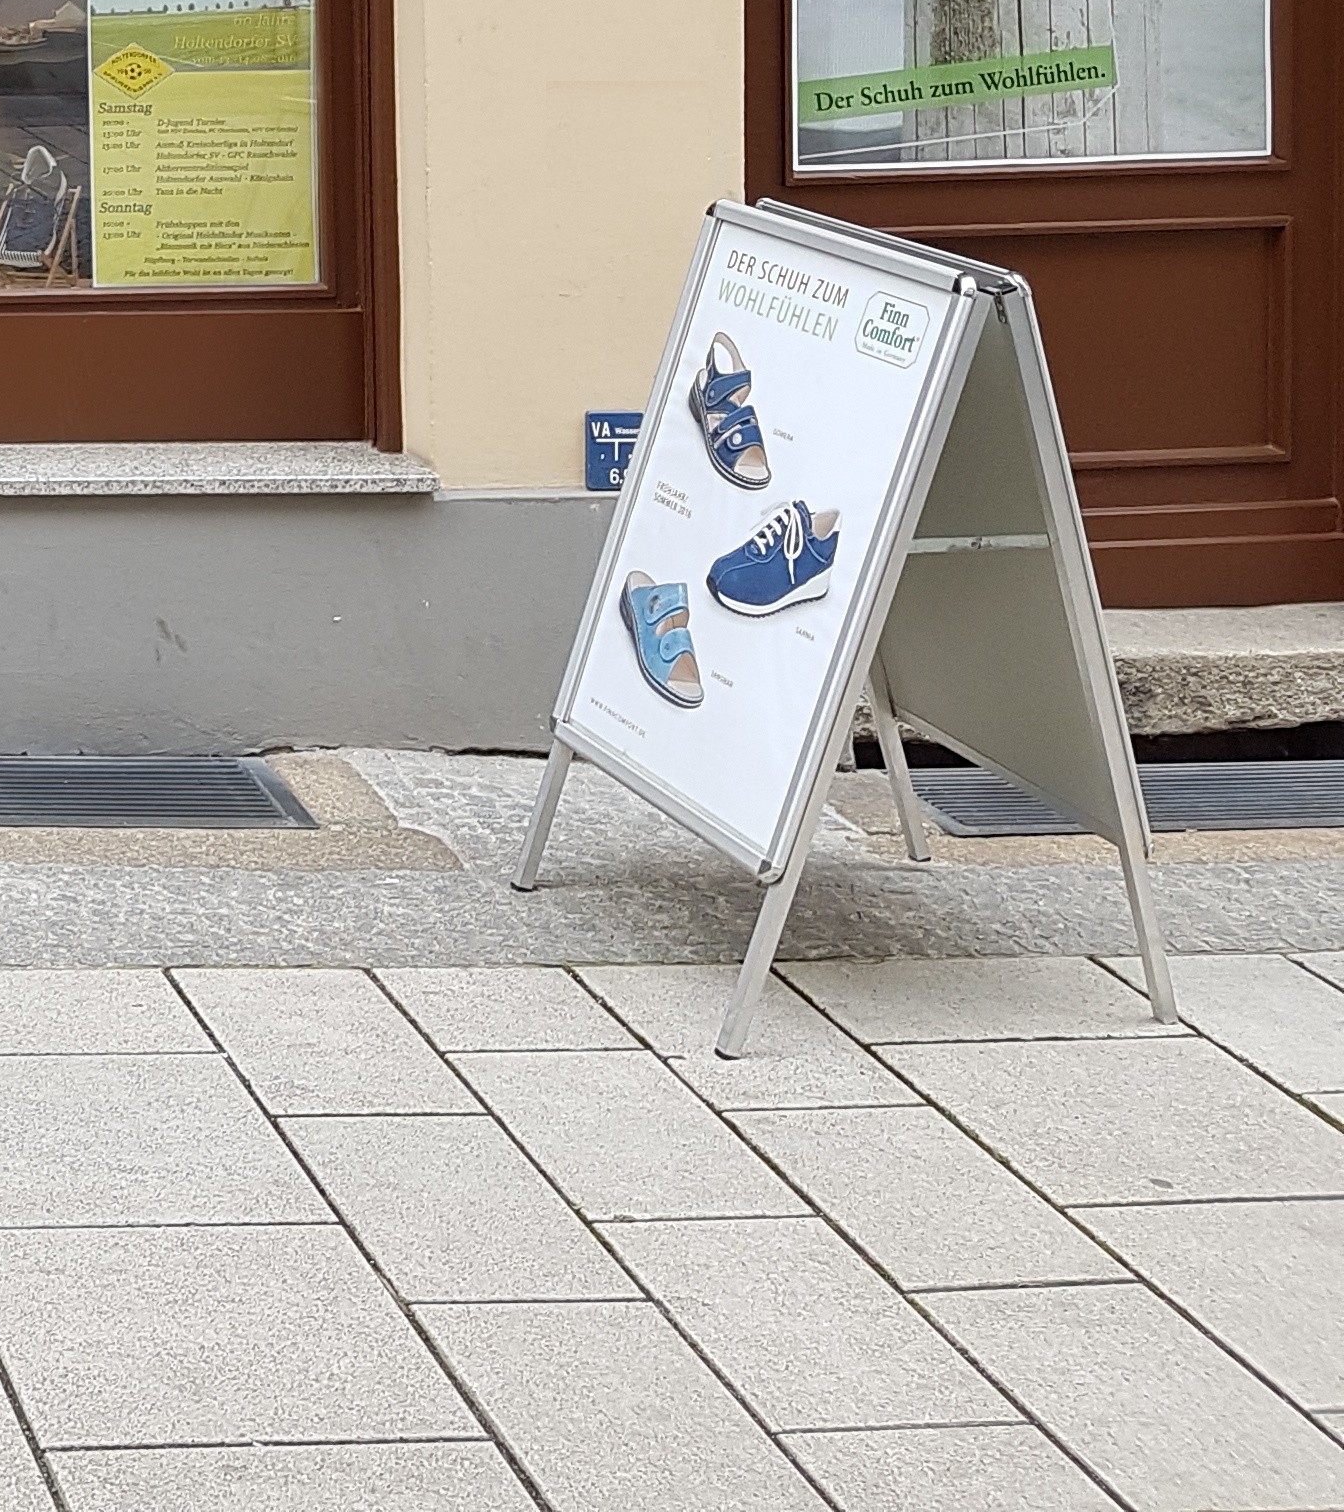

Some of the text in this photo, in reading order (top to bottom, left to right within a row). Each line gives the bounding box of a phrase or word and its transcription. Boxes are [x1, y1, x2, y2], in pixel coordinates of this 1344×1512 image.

[814, 61, 1107, 112] Der Schuh zum Wohlfühlen.
[98, 102, 153, 116] Samstag
[126, 129, 143, 138] Uhr
[125, 141, 142, 150] Uhr
[126, 164, 143, 174] Uhr
[127, 188, 144, 197] Uhr
[98, 202, 153, 216] Sonntag
[726, 249, 850, 310] DER SCHUH ZUM
[717, 277, 839, 342] WOHLFÜHLEN
[879, 301, 911, 329] Finn
[862, 319, 916, 354] Comfort
[591, 421, 611, 438] VA
[609, 467, 629, 485] 6,
